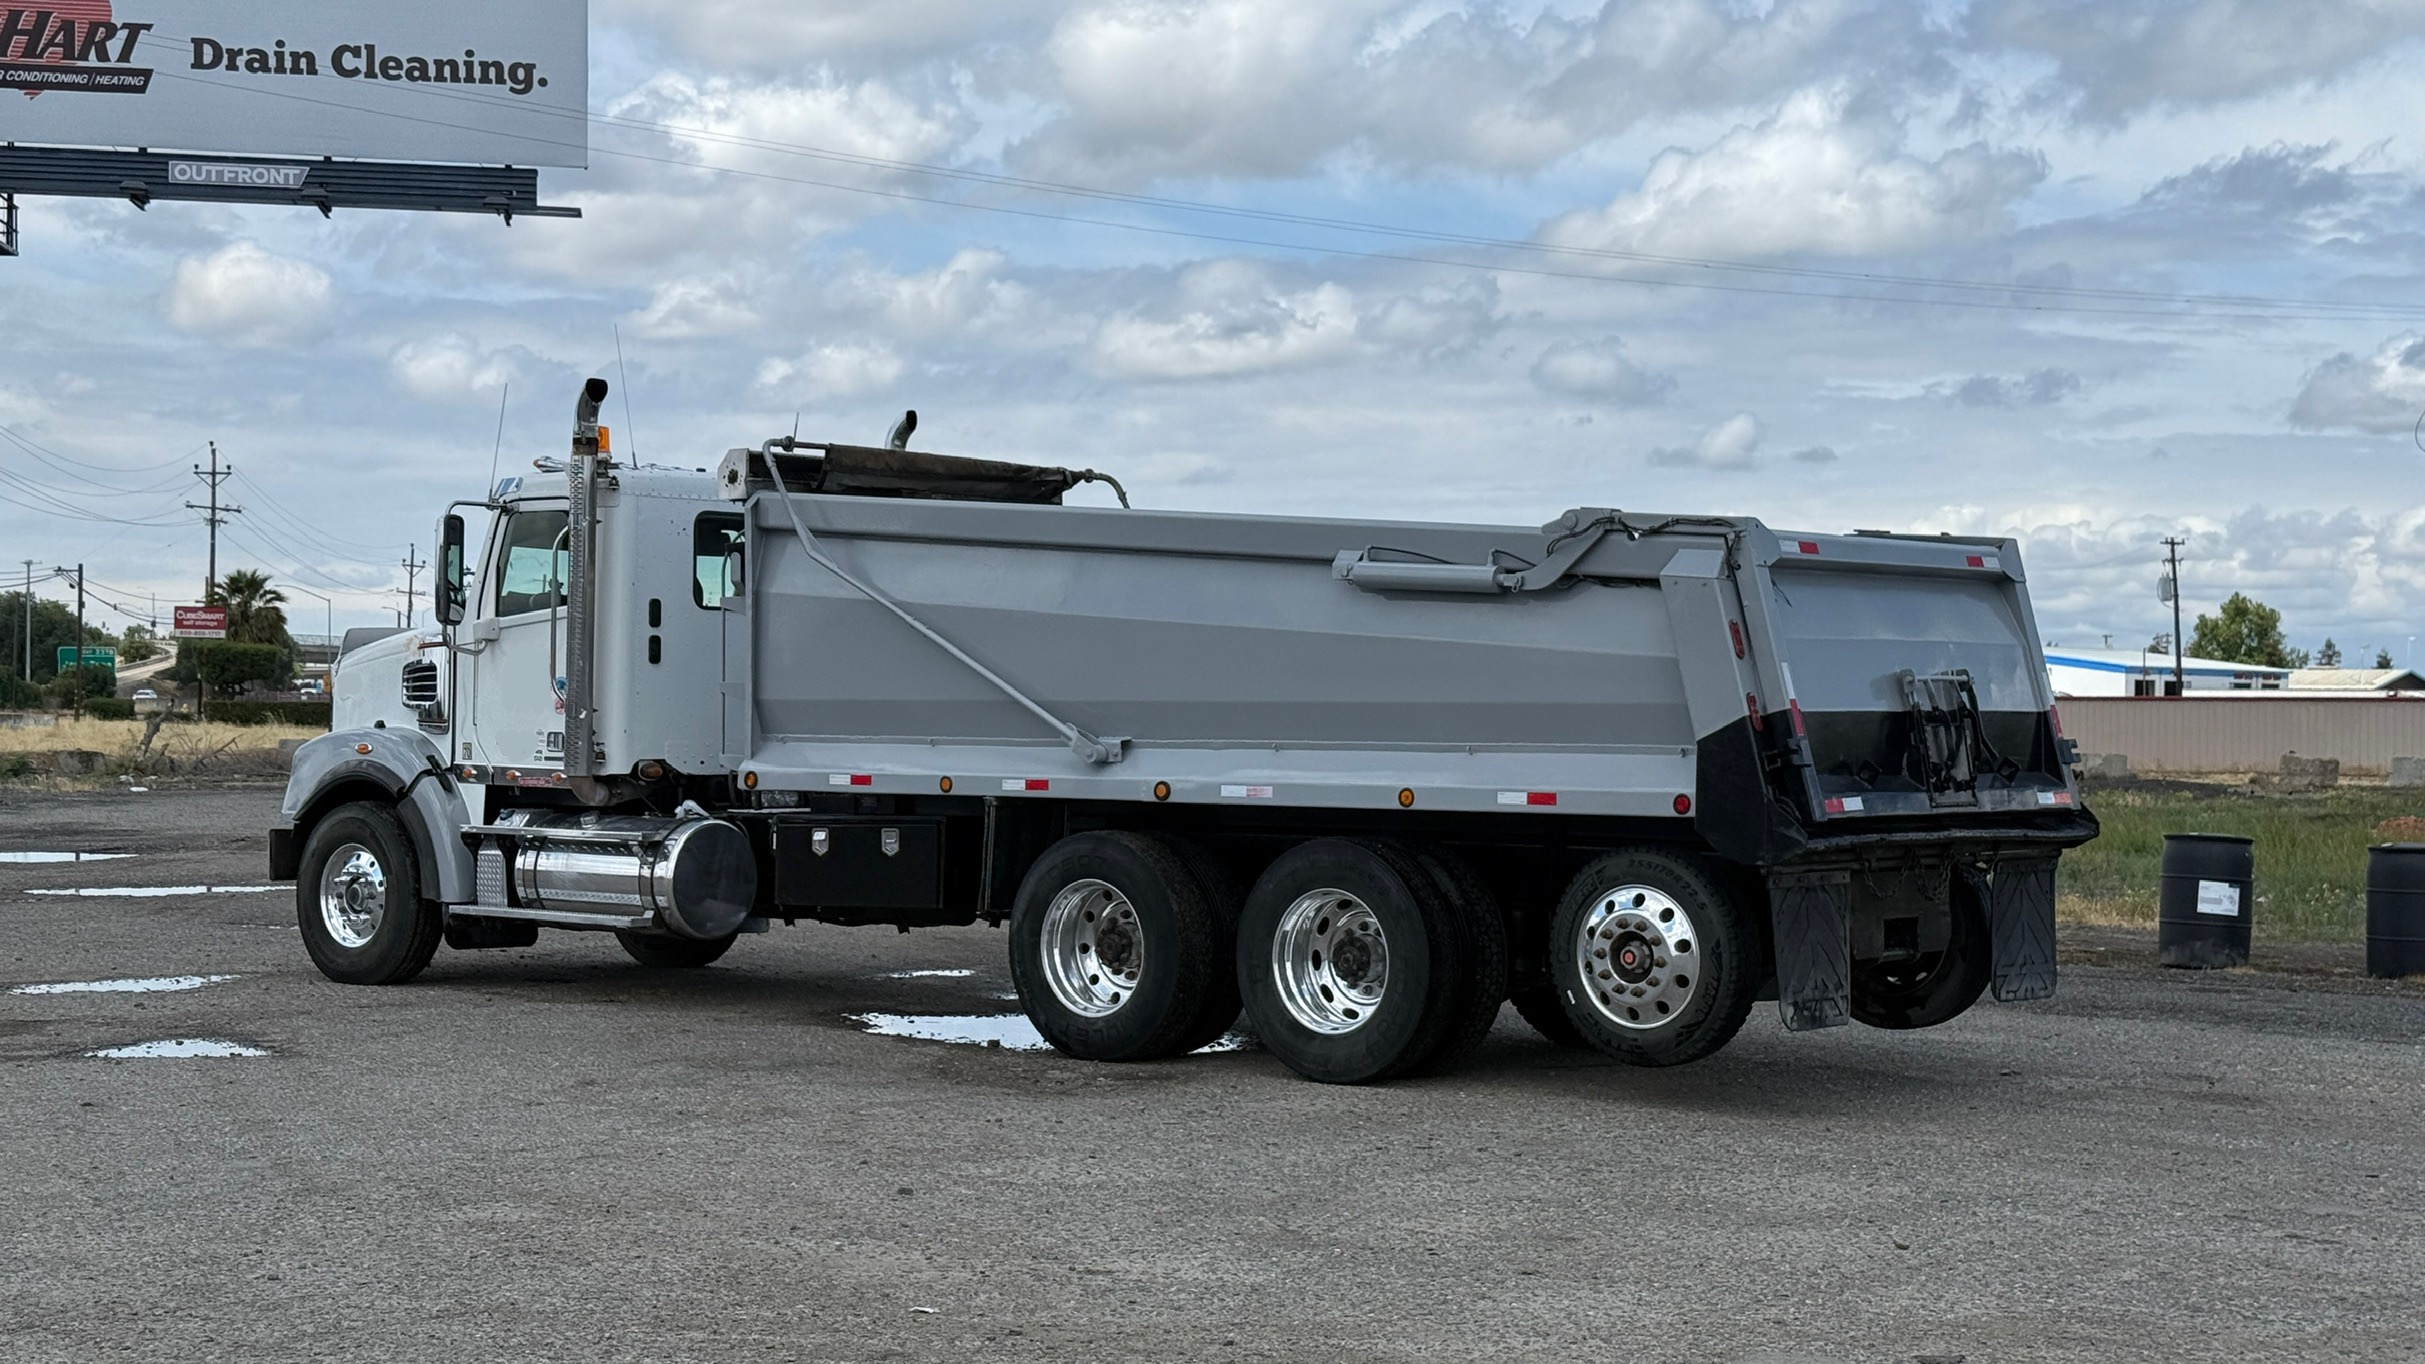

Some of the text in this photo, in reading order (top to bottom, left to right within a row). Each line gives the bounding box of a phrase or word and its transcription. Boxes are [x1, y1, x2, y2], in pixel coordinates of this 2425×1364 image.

[190, 38, 548, 95] Drain Cleaning.
[6, 70, 89, 84] CONDITIONING
[95, 75, 145, 86] HEATING
[174, 164, 300, 184] OUTFRONT
